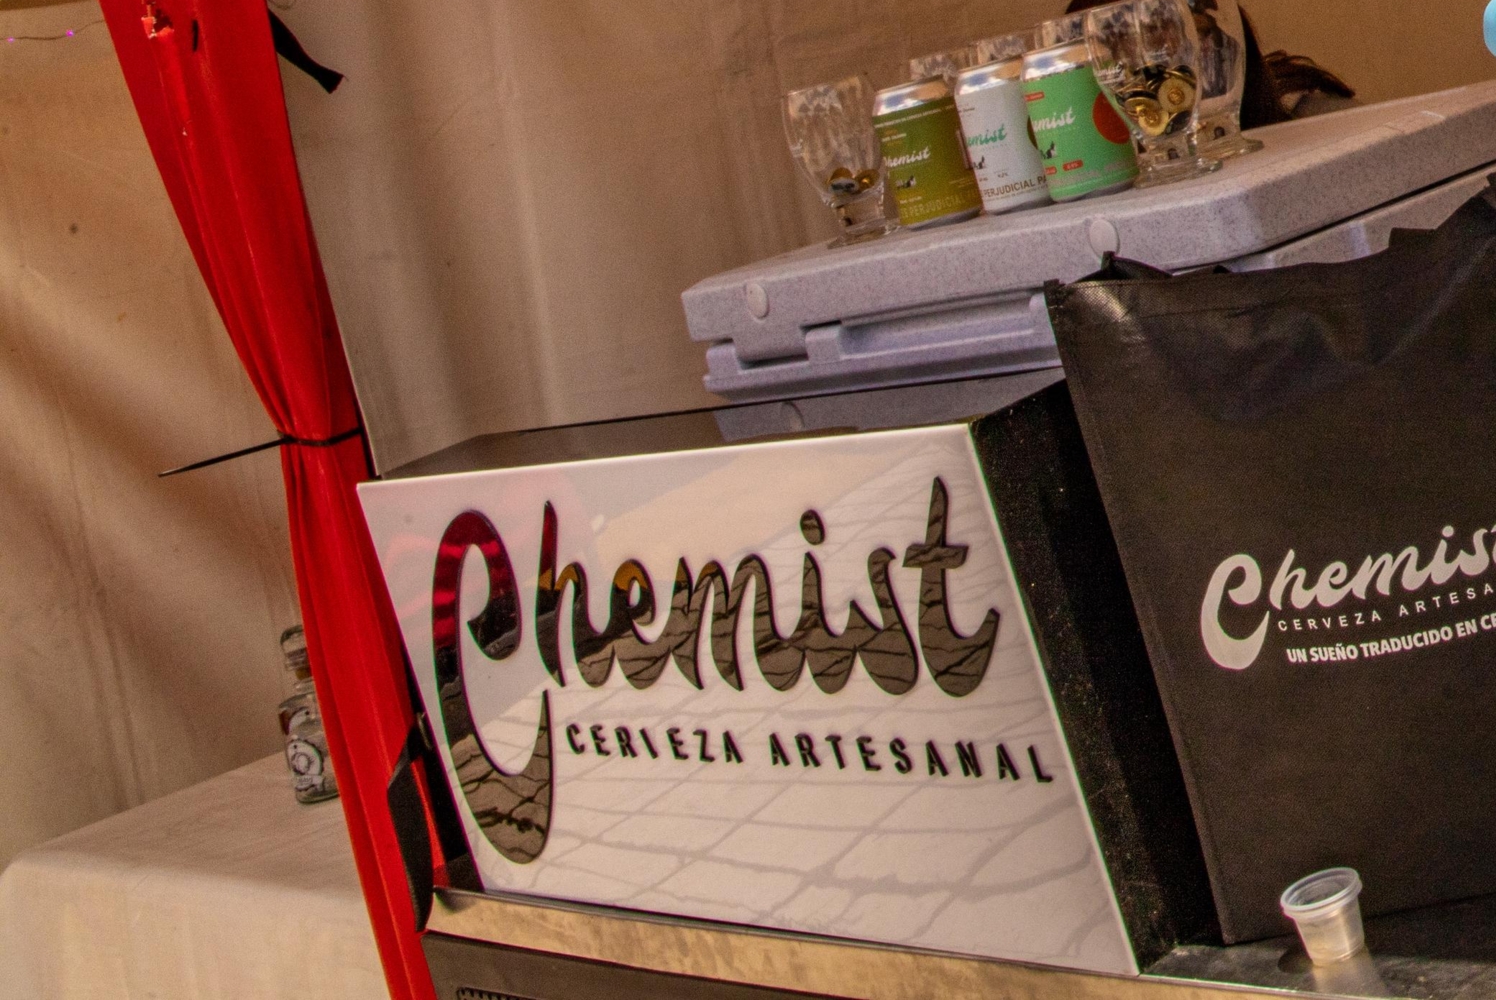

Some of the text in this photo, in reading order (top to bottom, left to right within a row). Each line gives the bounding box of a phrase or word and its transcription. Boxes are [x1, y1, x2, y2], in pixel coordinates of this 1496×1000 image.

[983, 178, 1035, 198] PERJUDICIAL
[1277, 609, 1382, 632] CERVEZA
[1286, 646, 1309, 664] UN
[1309, 638, 1359, 663] SUEÑO
[1360, 625, 1453, 659] TRADUCIDO
[1455, 618, 1479, 639] EN
[431, 475, 1000, 864] Chemist
[768, 731, 1054, 784] ARTESANAL
